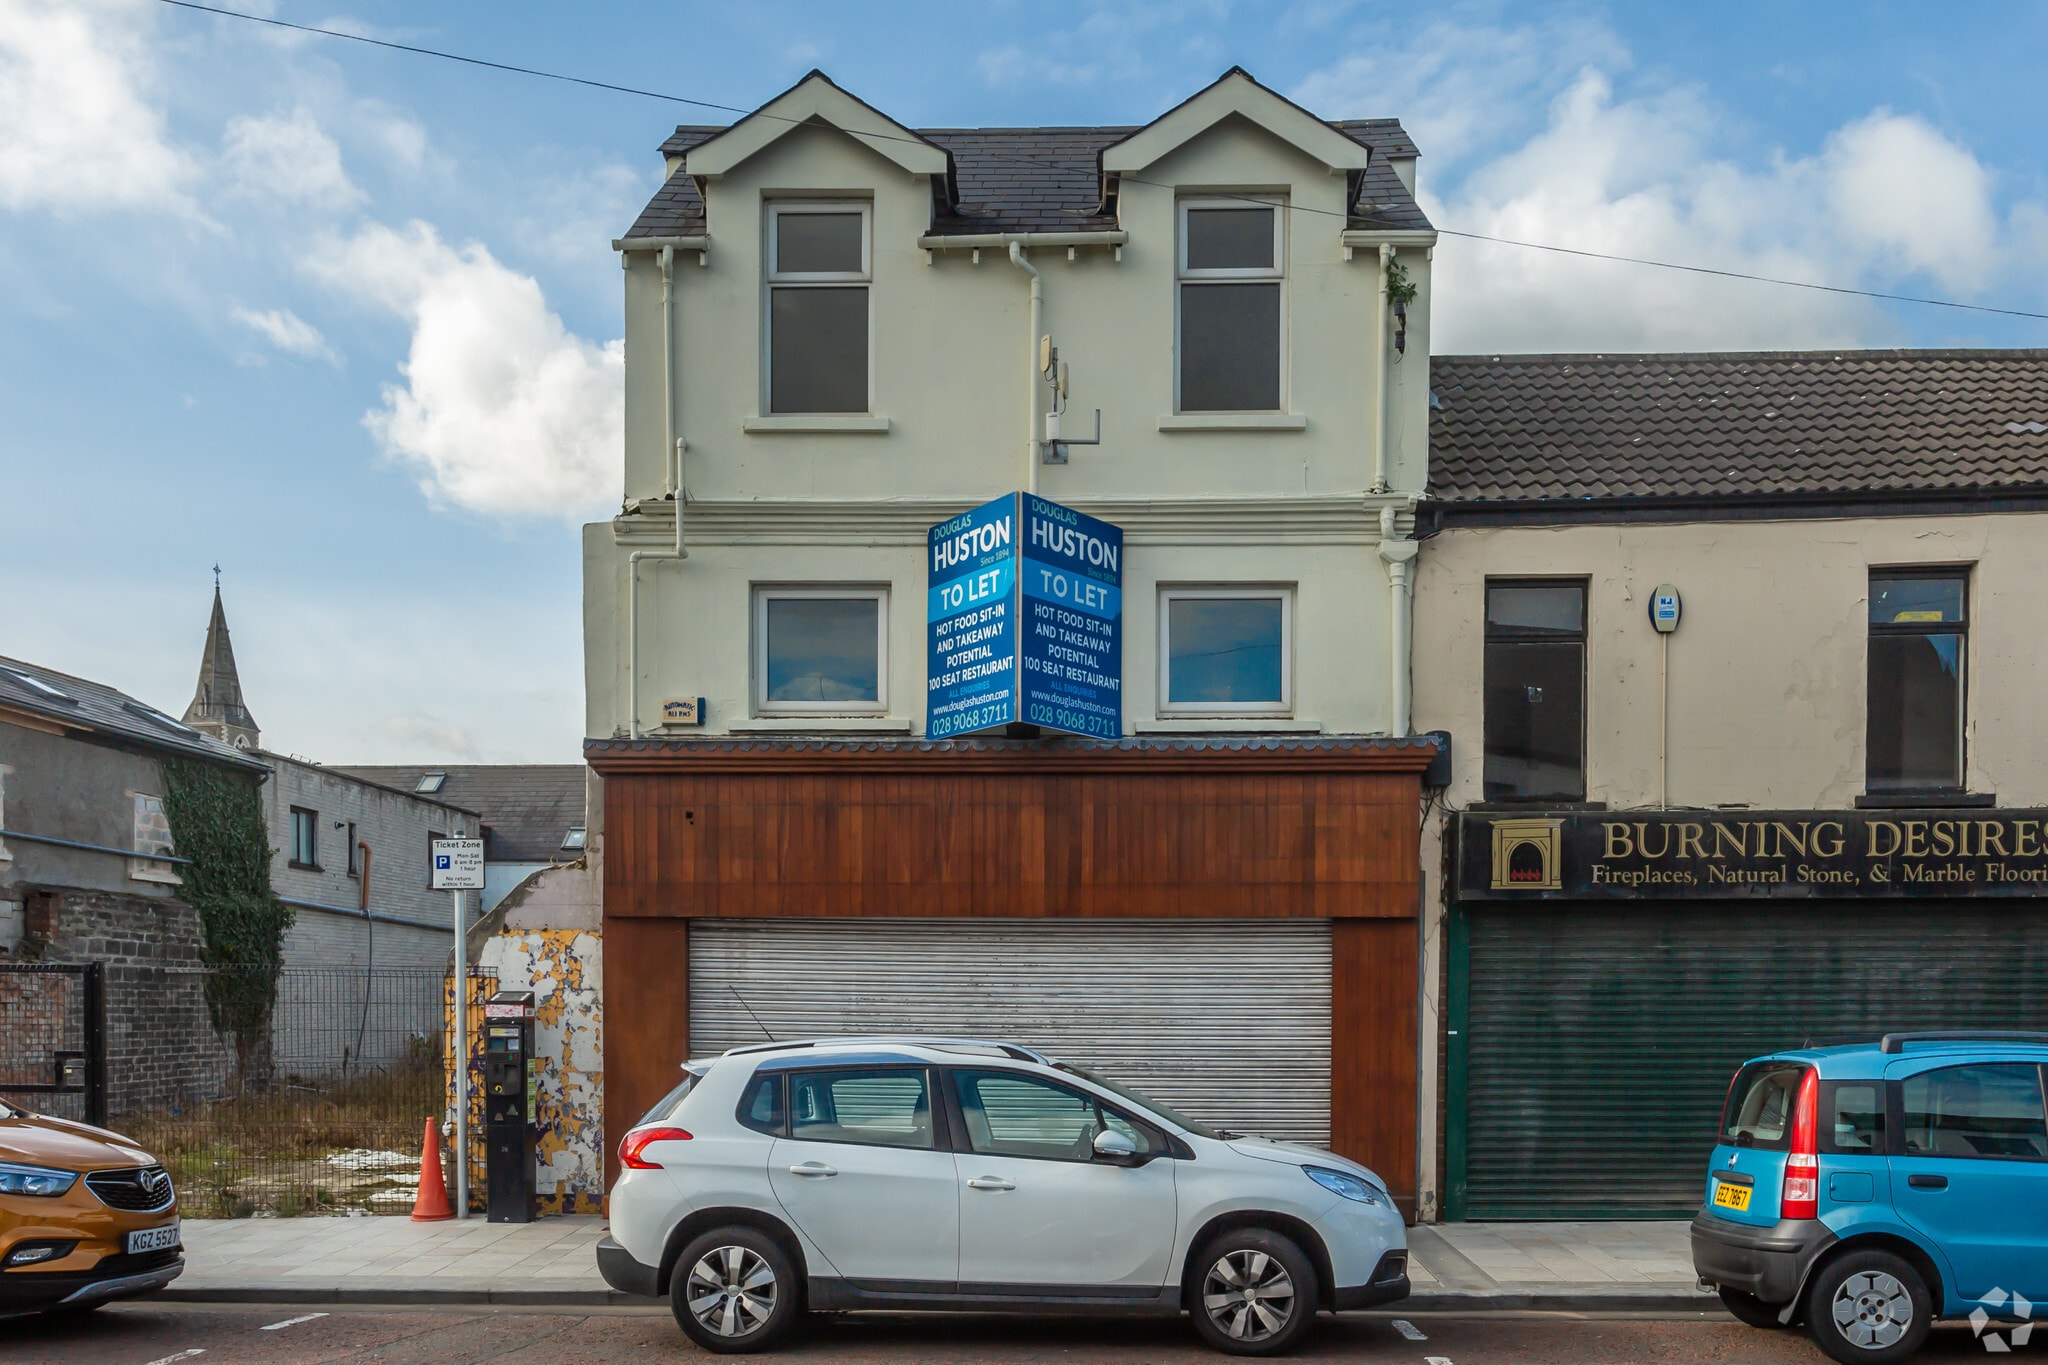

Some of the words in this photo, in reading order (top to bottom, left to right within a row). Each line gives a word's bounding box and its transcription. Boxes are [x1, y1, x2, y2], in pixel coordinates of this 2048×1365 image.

[1032, 498, 1077, 526] DOUGLAS
[934, 514, 972, 541] DOUGLAS
[934, 515, 1010, 572] HUSTON
[980, 555, 994, 566] Since
[995, 548, 1010, 561] 1894
[1032, 516, 1117, 572] HUSTON
[1087, 567, 1102, 578] Since
[1103, 572, 1117, 584] 1894
[941, 583, 963, 610] TO
[969, 569, 1000, 602] LET
[1040, 569, 1068, 598] TO
[1074, 580, 1108, 610] LET
[936, 620, 952, 637] HOT
[954, 612, 977, 632] FOOD
[979, 603, 1005, 623] SIT-IN
[1034, 603, 1055, 620] HOT
[1057, 609, 1084, 628] FOOD
[1086, 618, 1112, 637] SIT-IN
[937, 638, 954, 654] AND
[956, 622, 1004, 648] TAKEAWAY
[1035, 622, 1056, 638] AND
[1059, 628, 1111, 654] TAKEAWAY
[946, 644, 992, 668] POTENTIAL
[1048, 644, 1100, 669] POTENTIAL
[929, 678, 940, 691] 100
[942, 671, 961, 688] SEAT
[962, 656, 1014, 682] RESTAURANT
[1024, 656, 1040, 671] 100
[1042, 660, 1064, 677] SEAT
[1066, 666, 1120, 691] RESTAURANT
[933, 689, 1009, 715] www.douglashuston.com
[948, 688, 959, 699] ALL
[960, 680, 990, 696] ENQUIRIES
[1031, 689, 1116, 716] www.douglashuston.com
[1050, 680, 1062, 691] ALL
[1064, 683, 1097, 699] ENQUIRIES
[663, 701, 696, 712] AUTOMATIC
[932, 716, 951, 736] 028
[953, 709, 979, 731] 9068
[981, 702, 1008, 725] 3711
[1030, 703, 1053, 724] 028
[1056, 709, 1085, 730] 9068
[1088, 715, 1116, 737] 3711
[1601, 820, 1846, 859] BURNING
[1864, 820, 2048, 858] DESIRE
[439, 857, 447, 868] P
[1591, 864, 1698, 888] Fireplaces,
[1707, 864, 1787, 884] Natural
[1796, 864, 1860, 887] Stone,
[1869, 863, 1891, 883] &
[1902, 863, 1975, 883] Marble
[1717, 1186, 1730, 1203] EEZ
[133, 1232, 154, 1250] KGZ
[156, 1228, 178, 1247] 5527
